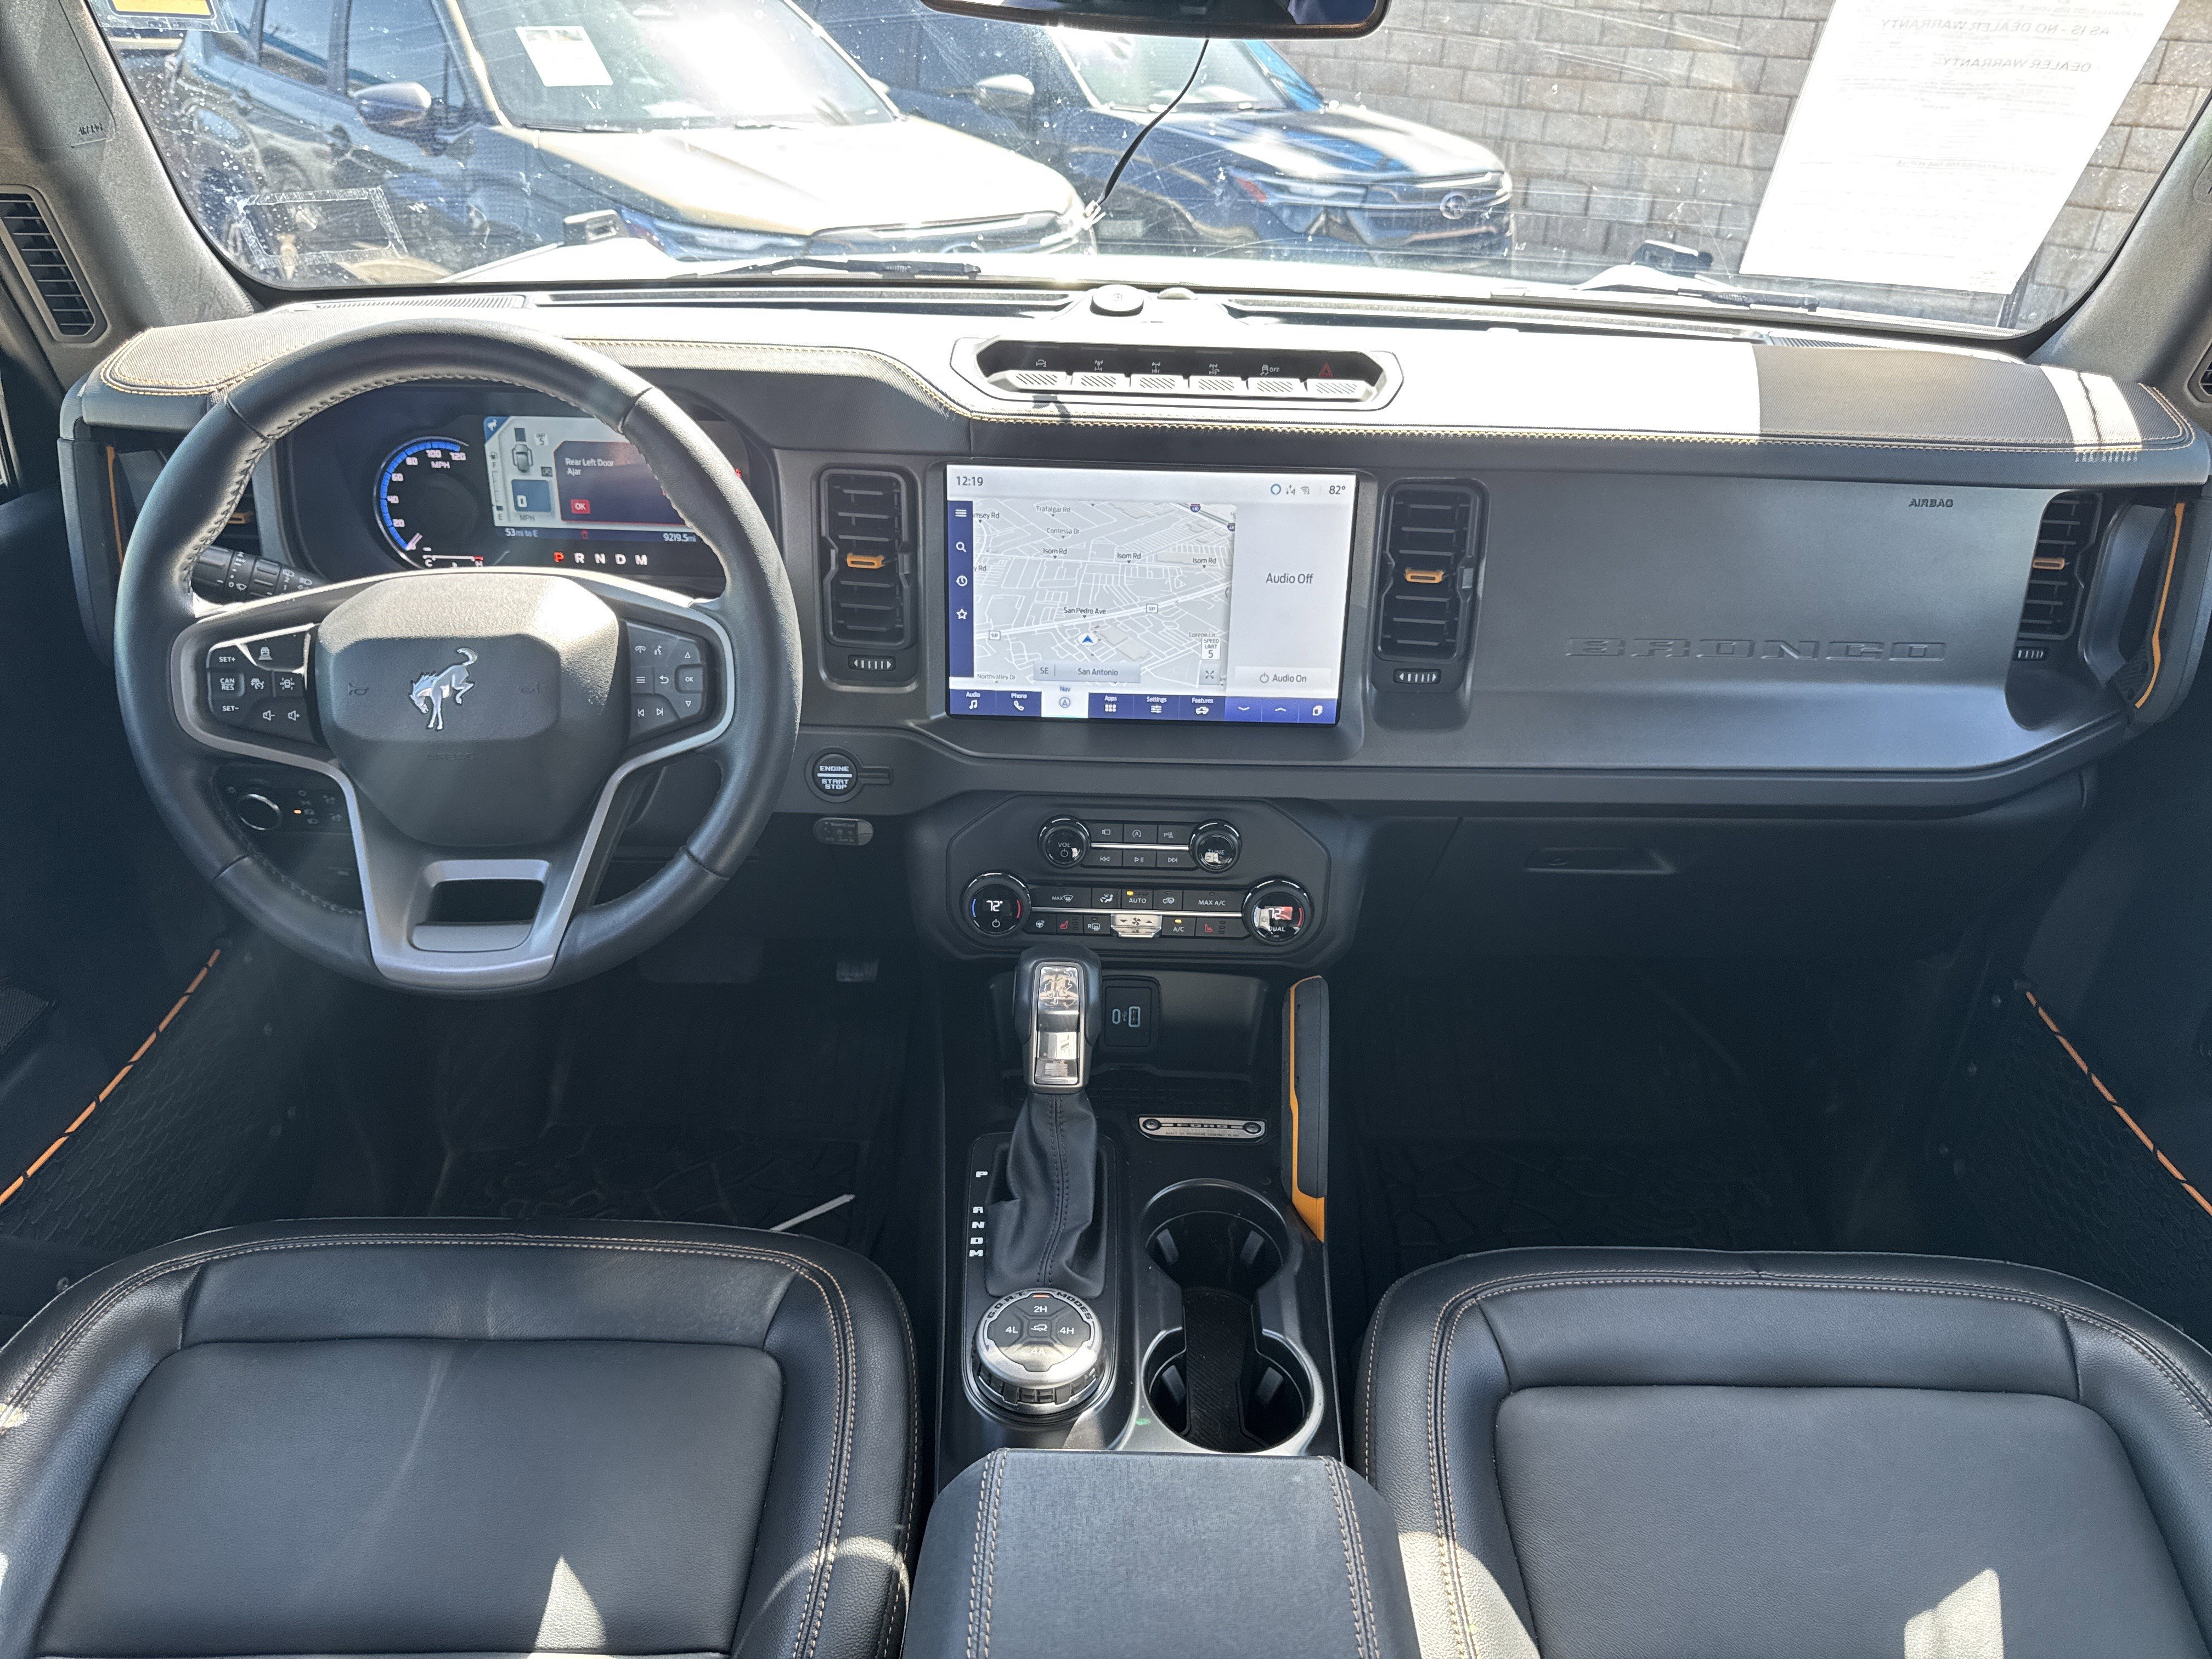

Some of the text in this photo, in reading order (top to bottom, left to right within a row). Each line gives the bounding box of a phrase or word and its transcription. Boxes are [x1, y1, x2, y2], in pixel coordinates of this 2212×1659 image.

[450, 452, 466, 460] 120
[567, 468, 582, 476] Ajar
[956, 476, 983, 486] 12:19
[1329, 485, 1346, 494] 82°
[387, 495, 399, 504] 40
[1908, 499, 1954, 507] AIRBAG
[575, 503, 586, 511] OK
[393, 519, 405, 527] 20
[554, 552, 648, 565] P R N D M
[1266, 573, 1313, 584] Audio Off
[1566, 637, 1947, 662] BRONCO
[1208, 650, 1214, 658] 5
[1272, 674, 1307, 682] Audio On
[1057, 1291, 1093, 1319] MODES
